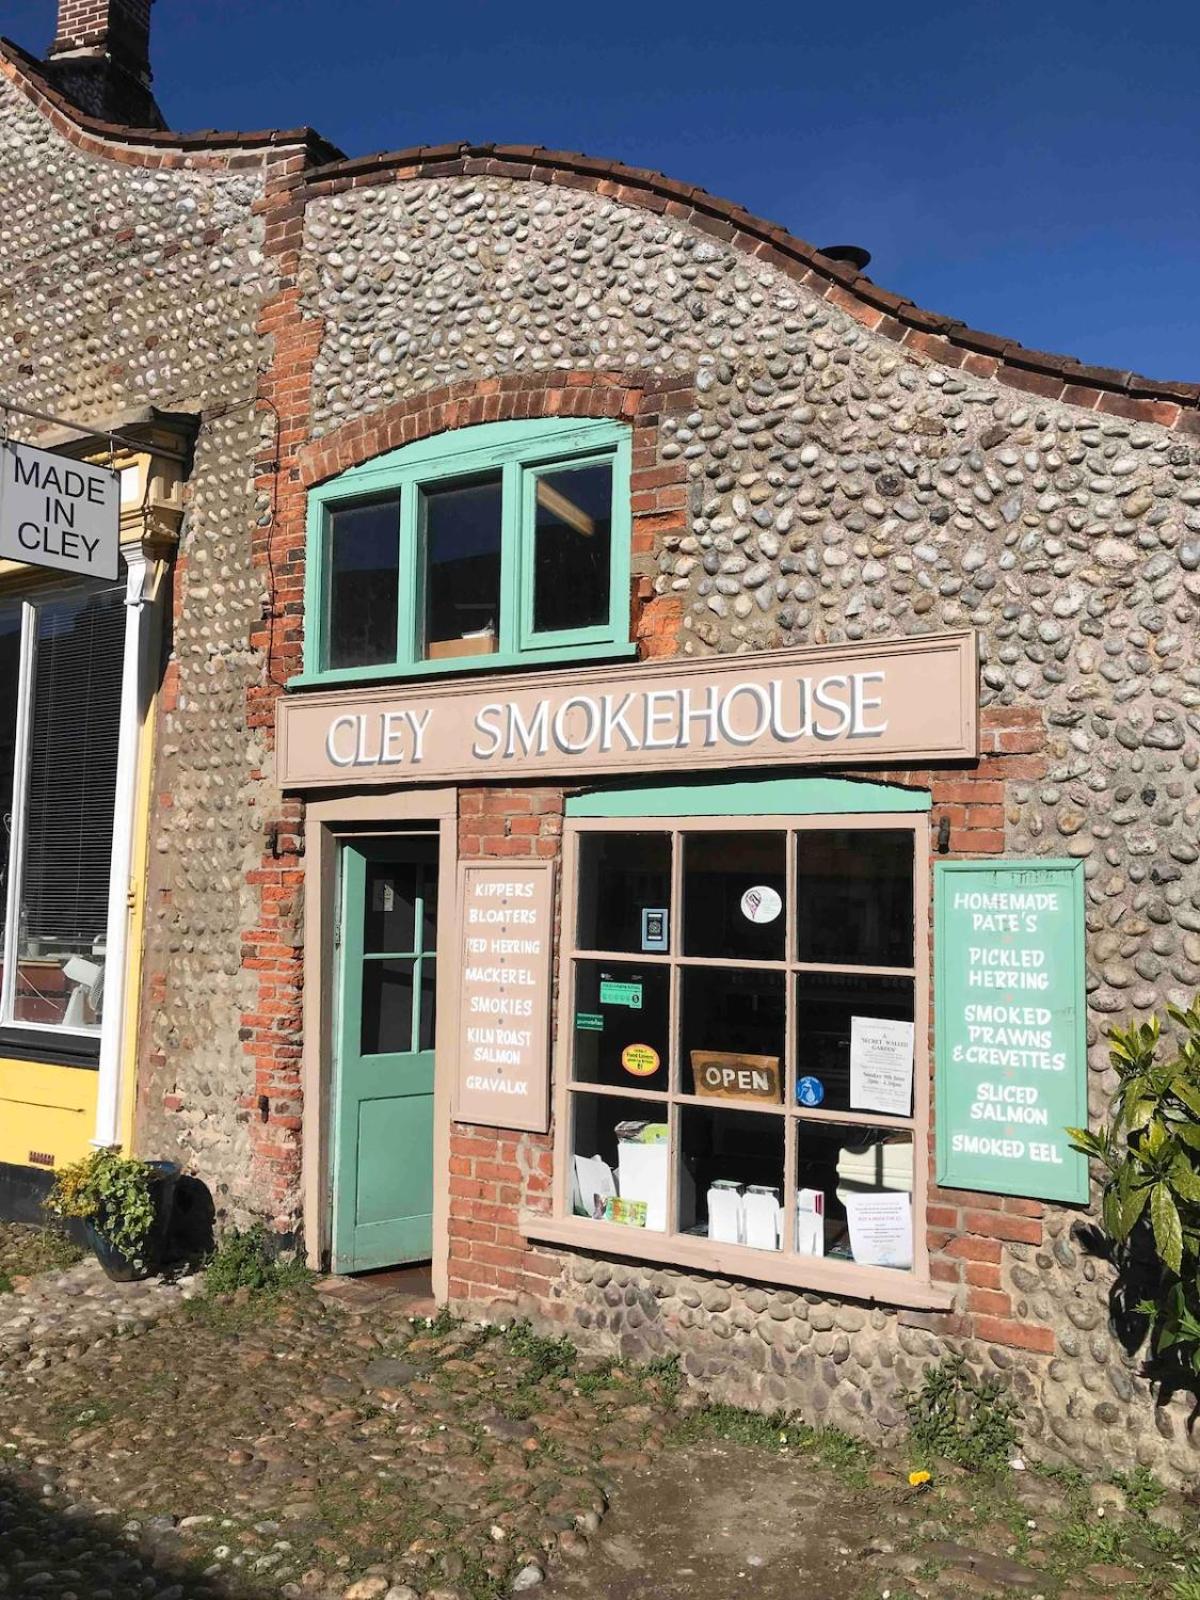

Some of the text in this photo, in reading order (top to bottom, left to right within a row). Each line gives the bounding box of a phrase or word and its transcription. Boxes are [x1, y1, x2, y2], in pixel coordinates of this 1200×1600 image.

[14, 455, 105, 505] MADE
[46, 496, 74, 528] IN
[18, 522, 100, 562] CLEY
[325, 671, 889, 767] CLEY SMOKEHOUSE
[475, 883, 534, 897] KIPPERS
[954, 892, 1059, 911] HOMEMADE
[469, 909, 537, 924] BLOATERS
[972, 913, 1038, 933] PATE'S
[466, 938, 540, 955] RED HERRING
[968, 947, 1045, 967] PICKLED
[465, 968, 536, 985] MACKEREL
[969, 970, 1049, 990] HERRING
[470, 996, 533, 1016] SMOKIES
[964, 1004, 1052, 1025] SMOKED
[467, 1027, 531, 1047] KILN ROAST
[967, 1025, 1052, 1049] PRAWNS
[473, 1047, 520, 1064] SALMON
[466, 1076, 528, 1095] GRAVALAX
[705, 1067, 769, 1091] OPEN
[977, 1082, 1038, 1105] SLICED
[970, 1102, 1048, 1126] SALMON
[952, 1134, 1063, 1164] SMOKED EEL
